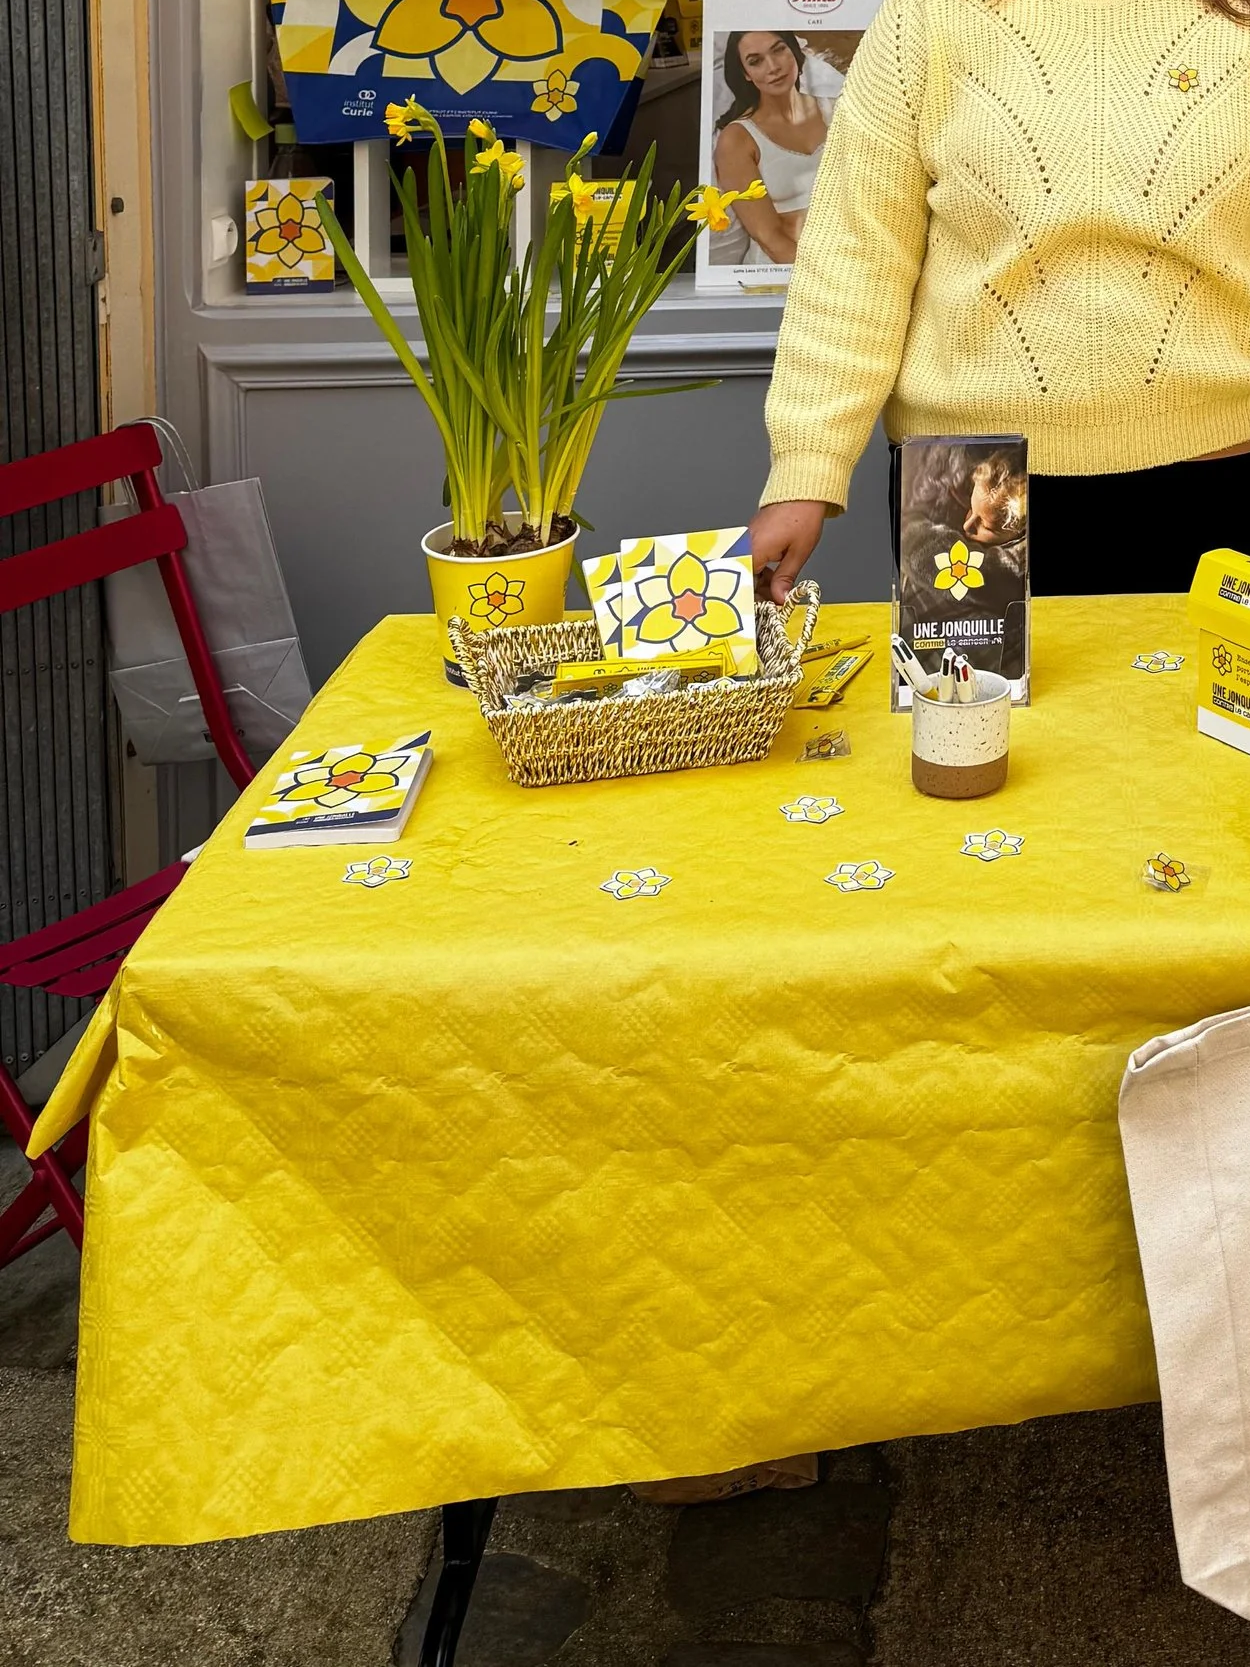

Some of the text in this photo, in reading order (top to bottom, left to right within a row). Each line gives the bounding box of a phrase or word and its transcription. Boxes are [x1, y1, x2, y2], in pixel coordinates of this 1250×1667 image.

[342, 108, 373, 117] Curie
[344, 99, 374, 109] institut
[1221, 574, 1239, 591] UNE
[913, 618, 1005, 639] UNE JONQUILLE
[1212, 682, 1227, 700] UNE
